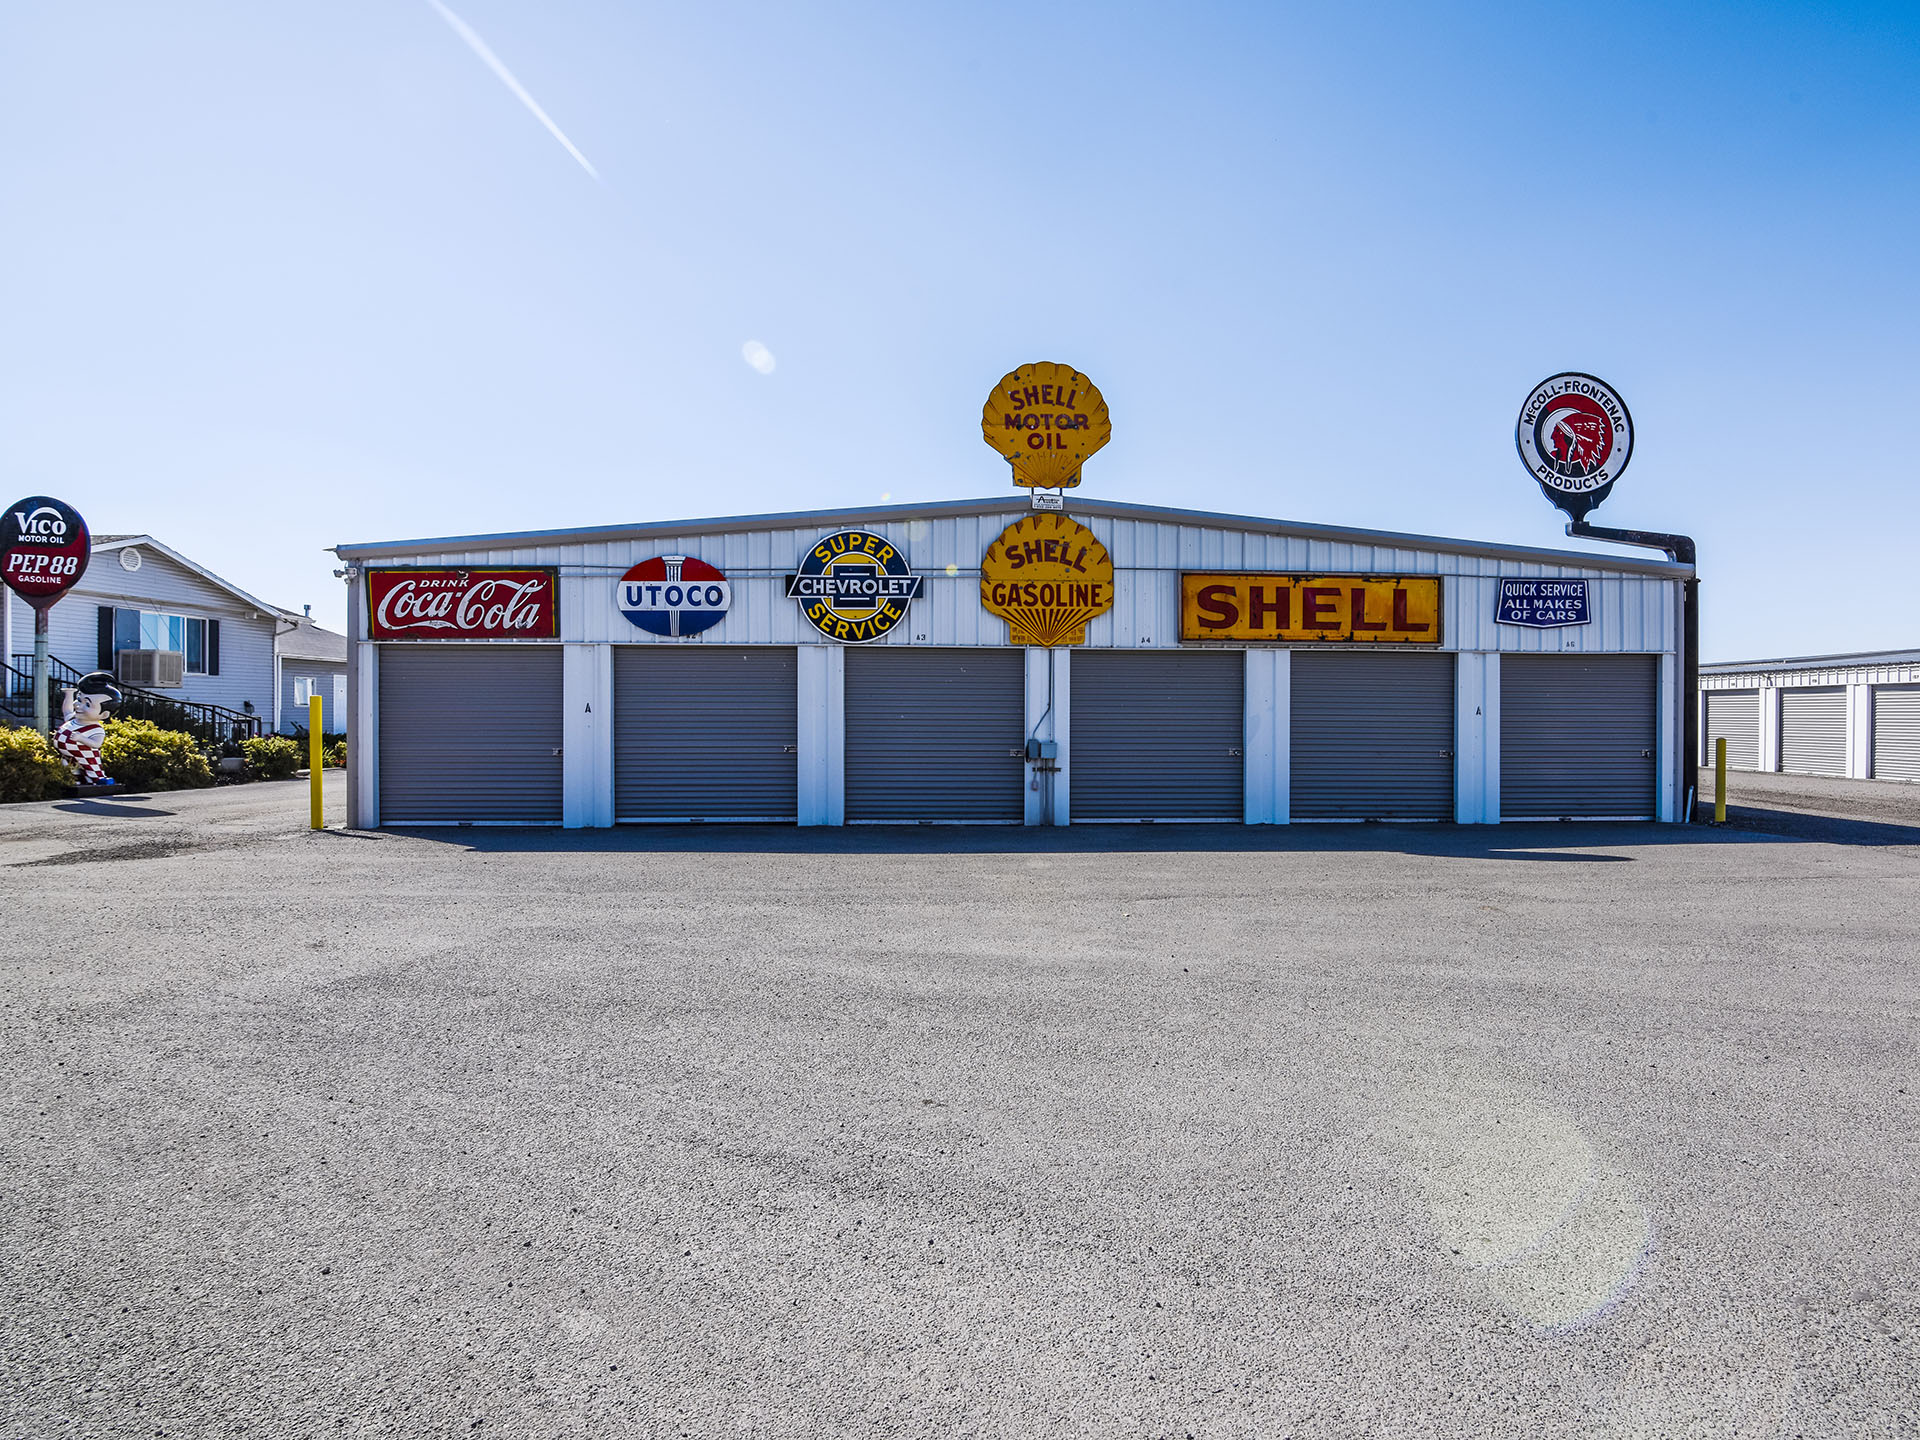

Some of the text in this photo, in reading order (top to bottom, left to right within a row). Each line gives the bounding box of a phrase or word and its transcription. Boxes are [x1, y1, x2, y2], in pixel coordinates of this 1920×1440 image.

[1009, 384, 1077, 411] SHELL
[1004, 413, 1090, 431] MOTOR
[1027, 432, 1068, 450] OIL
[1536, 464, 1609, 491] PRODUCTS
[18, 534, 65, 544] MOTOR OIL
[814, 533, 894, 565] SUPER
[1005, 539, 1088, 574] SHELL
[7, 553, 78, 575] PEP 88
[18, 575, 62, 584] GASOLINE
[419, 579, 470, 588] DRINK
[799, 579, 912, 595] CHEVROLET
[626, 585, 723, 607] UTOCO
[991, 583, 1103, 608] GASOLINE
[1505, 583, 1583, 597] QUICK SERVICE
[377, 579, 548, 630] Coca-Cola
[1197, 585, 1430, 632] SHELL
[1504, 599, 1582, 609] ALL MAKES
[808, 602, 902, 639] SERVICE
[1511, 610, 1577, 621] OF CARS
[1141, 636, 1151, 644] A4
[584, 702, 592, 713] A
[1475, 705, 1482, 716] A
